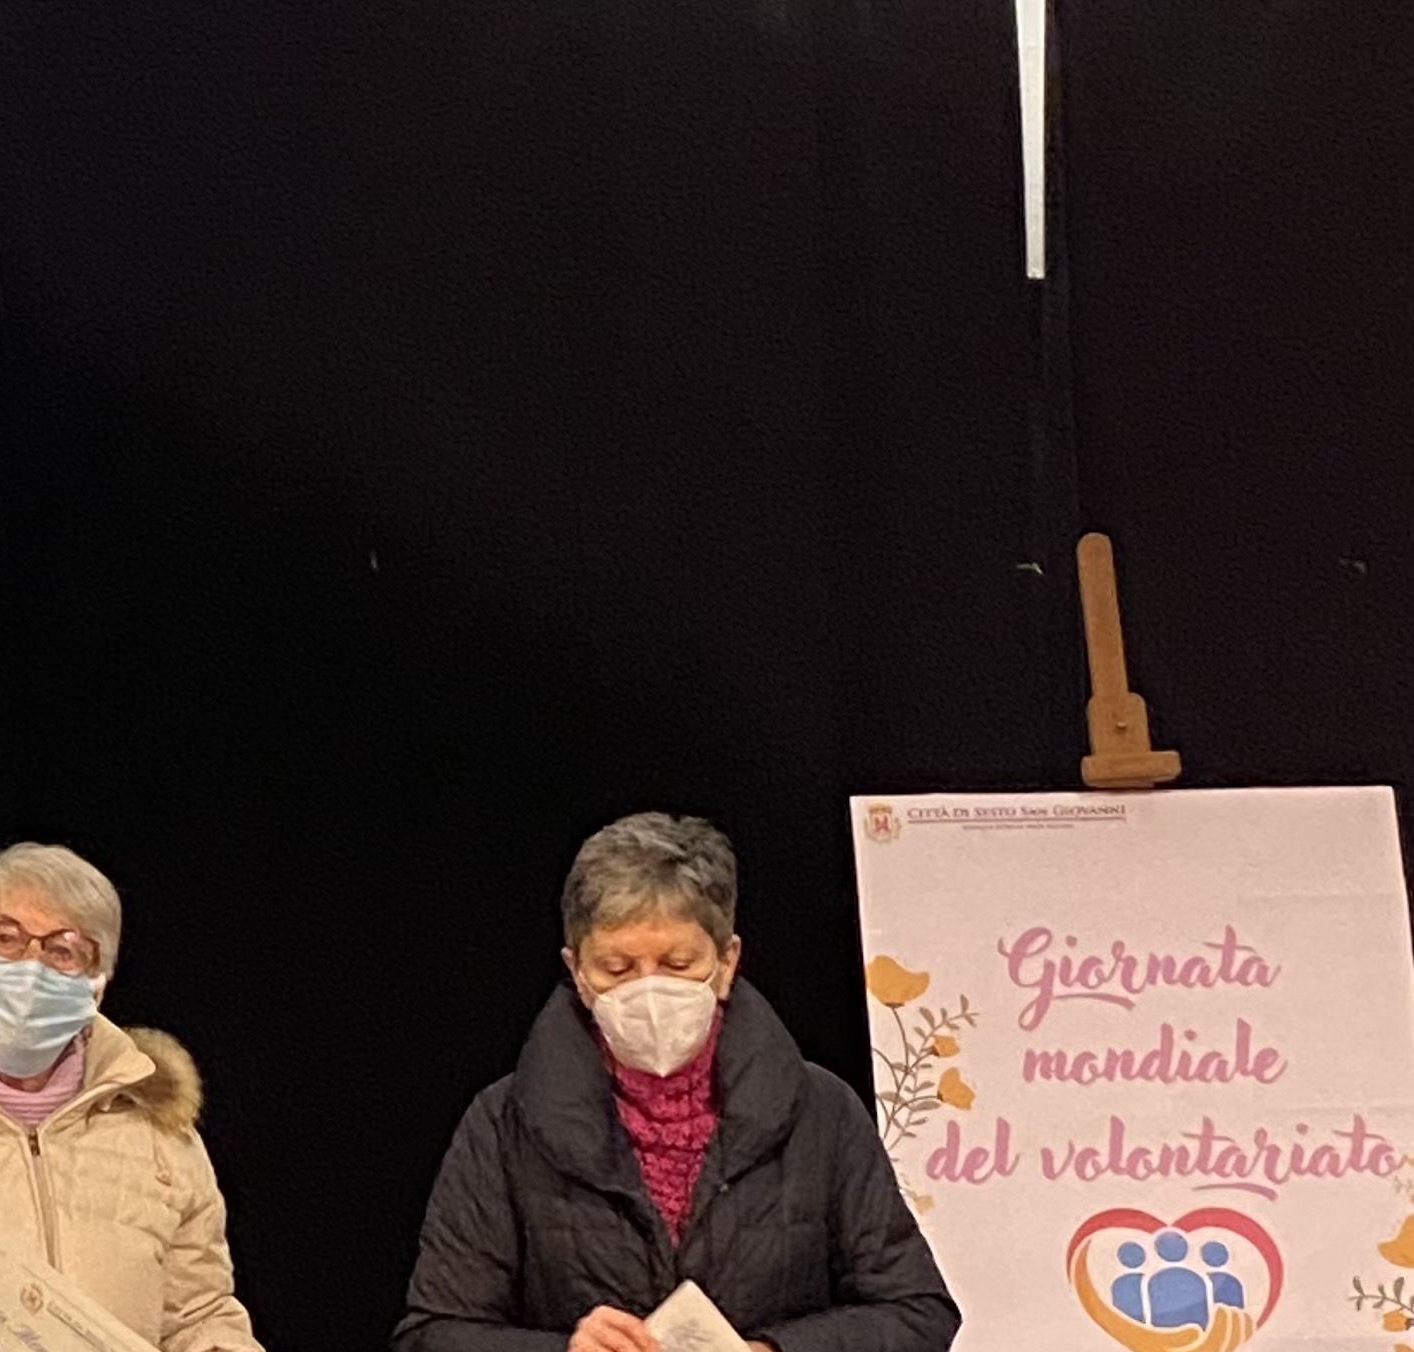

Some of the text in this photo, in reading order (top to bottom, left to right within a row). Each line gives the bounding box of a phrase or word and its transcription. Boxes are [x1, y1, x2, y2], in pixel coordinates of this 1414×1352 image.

[997, 923, 1282, 1031] Giornata
[1022, 1017, 1289, 1085] mondiale
[925, 1112, 1409, 1201] del volontariato
